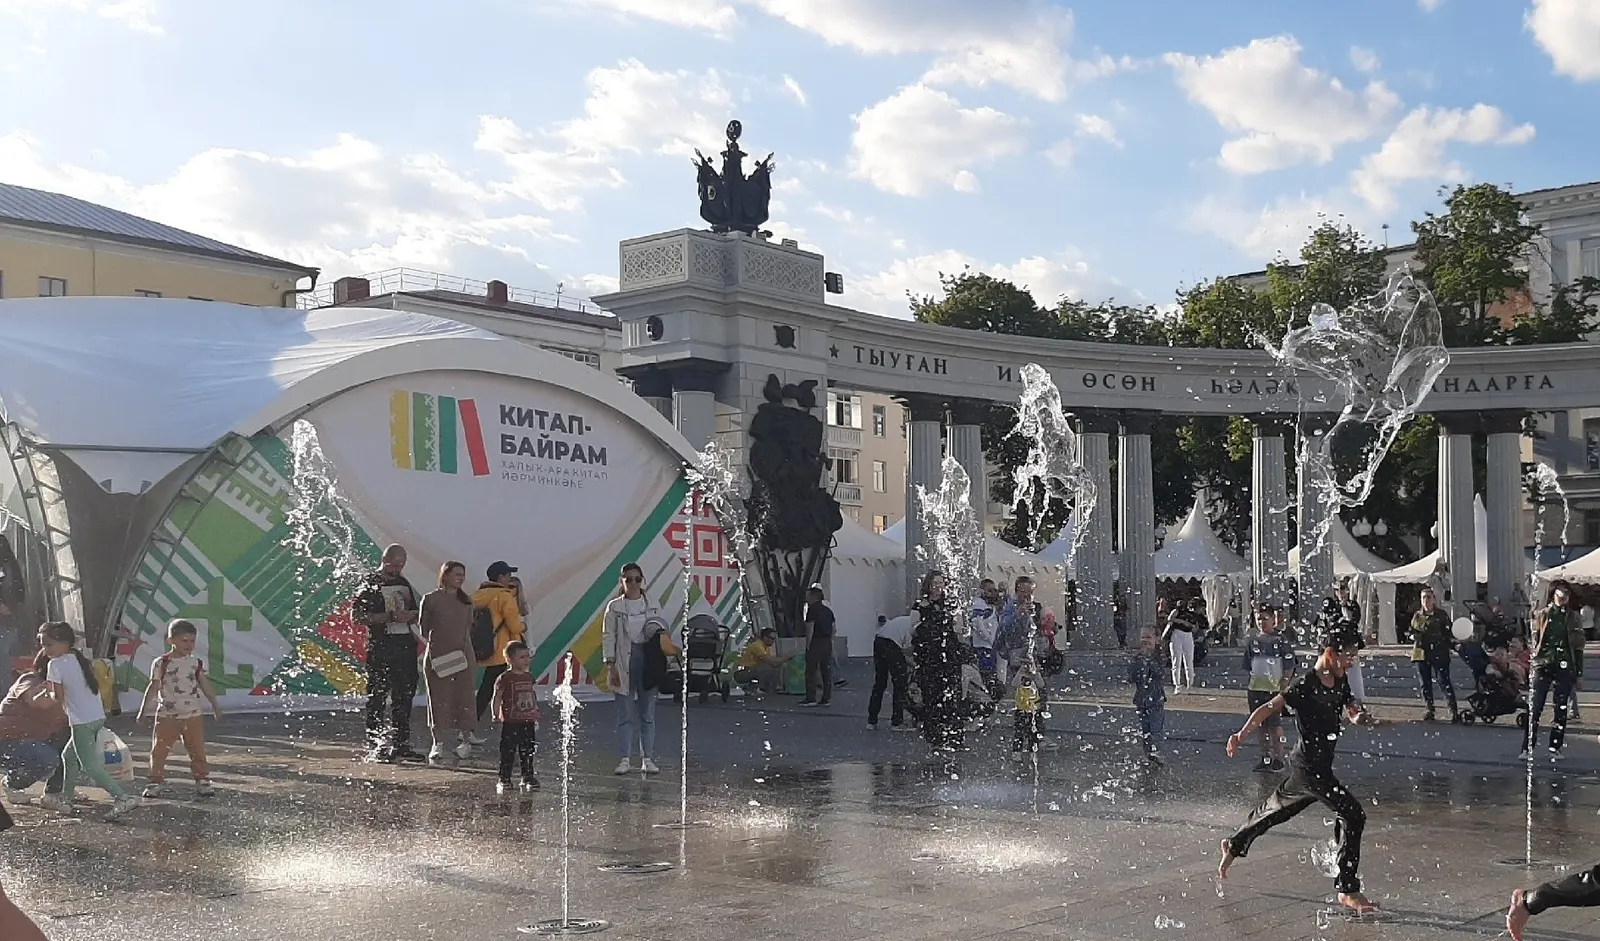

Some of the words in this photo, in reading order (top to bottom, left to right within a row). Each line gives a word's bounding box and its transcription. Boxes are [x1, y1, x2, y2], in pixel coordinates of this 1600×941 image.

[853, 345, 948, 375] ТЫУҒАН
[1082, 372, 1156, 392] ӨСӨН
[499, 404, 592, 435] КИТАП-
[500, 433, 607, 466] БАЙРАМ
[572, 468, 608, 480] КИТАП
